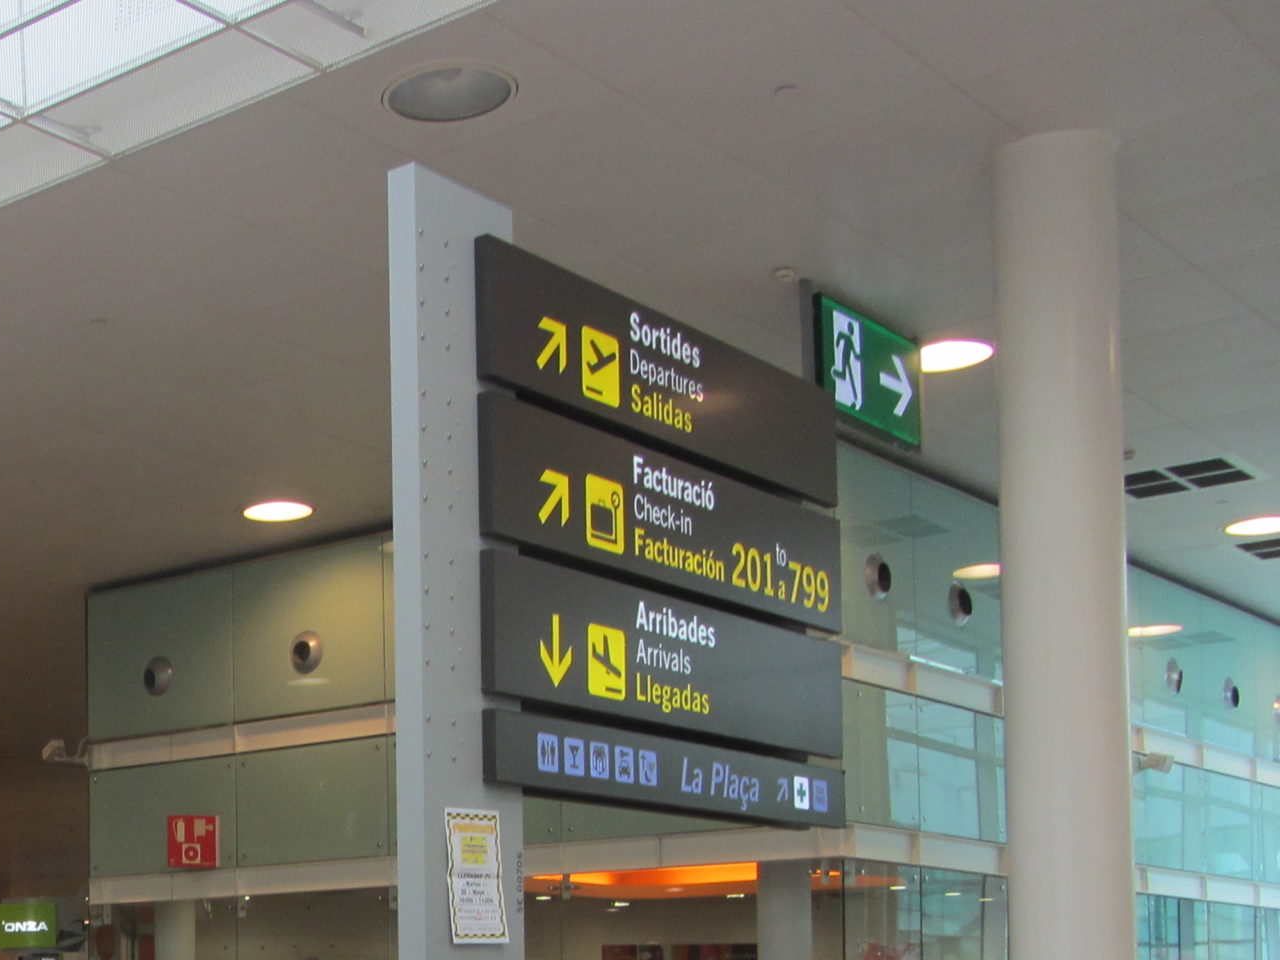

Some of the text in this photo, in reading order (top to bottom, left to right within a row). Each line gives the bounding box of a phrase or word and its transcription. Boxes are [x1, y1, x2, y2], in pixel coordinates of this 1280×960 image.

[629, 311, 700, 369] Sortides
[629, 349, 704, 402] Departures
[630, 384, 693, 433] Salidas
[632, 455, 715, 511] Facturació
[634, 494, 693, 536] Check-in
[634, 527, 830, 612] Facturación 201 a 799
[775, 543, 787, 567] to
[635, 600, 716, 648] Arribades
[636, 639, 692, 675] Arrivals
[635, 672, 710, 715] Llegadas
[680, 757, 760, 811] La Plaça
